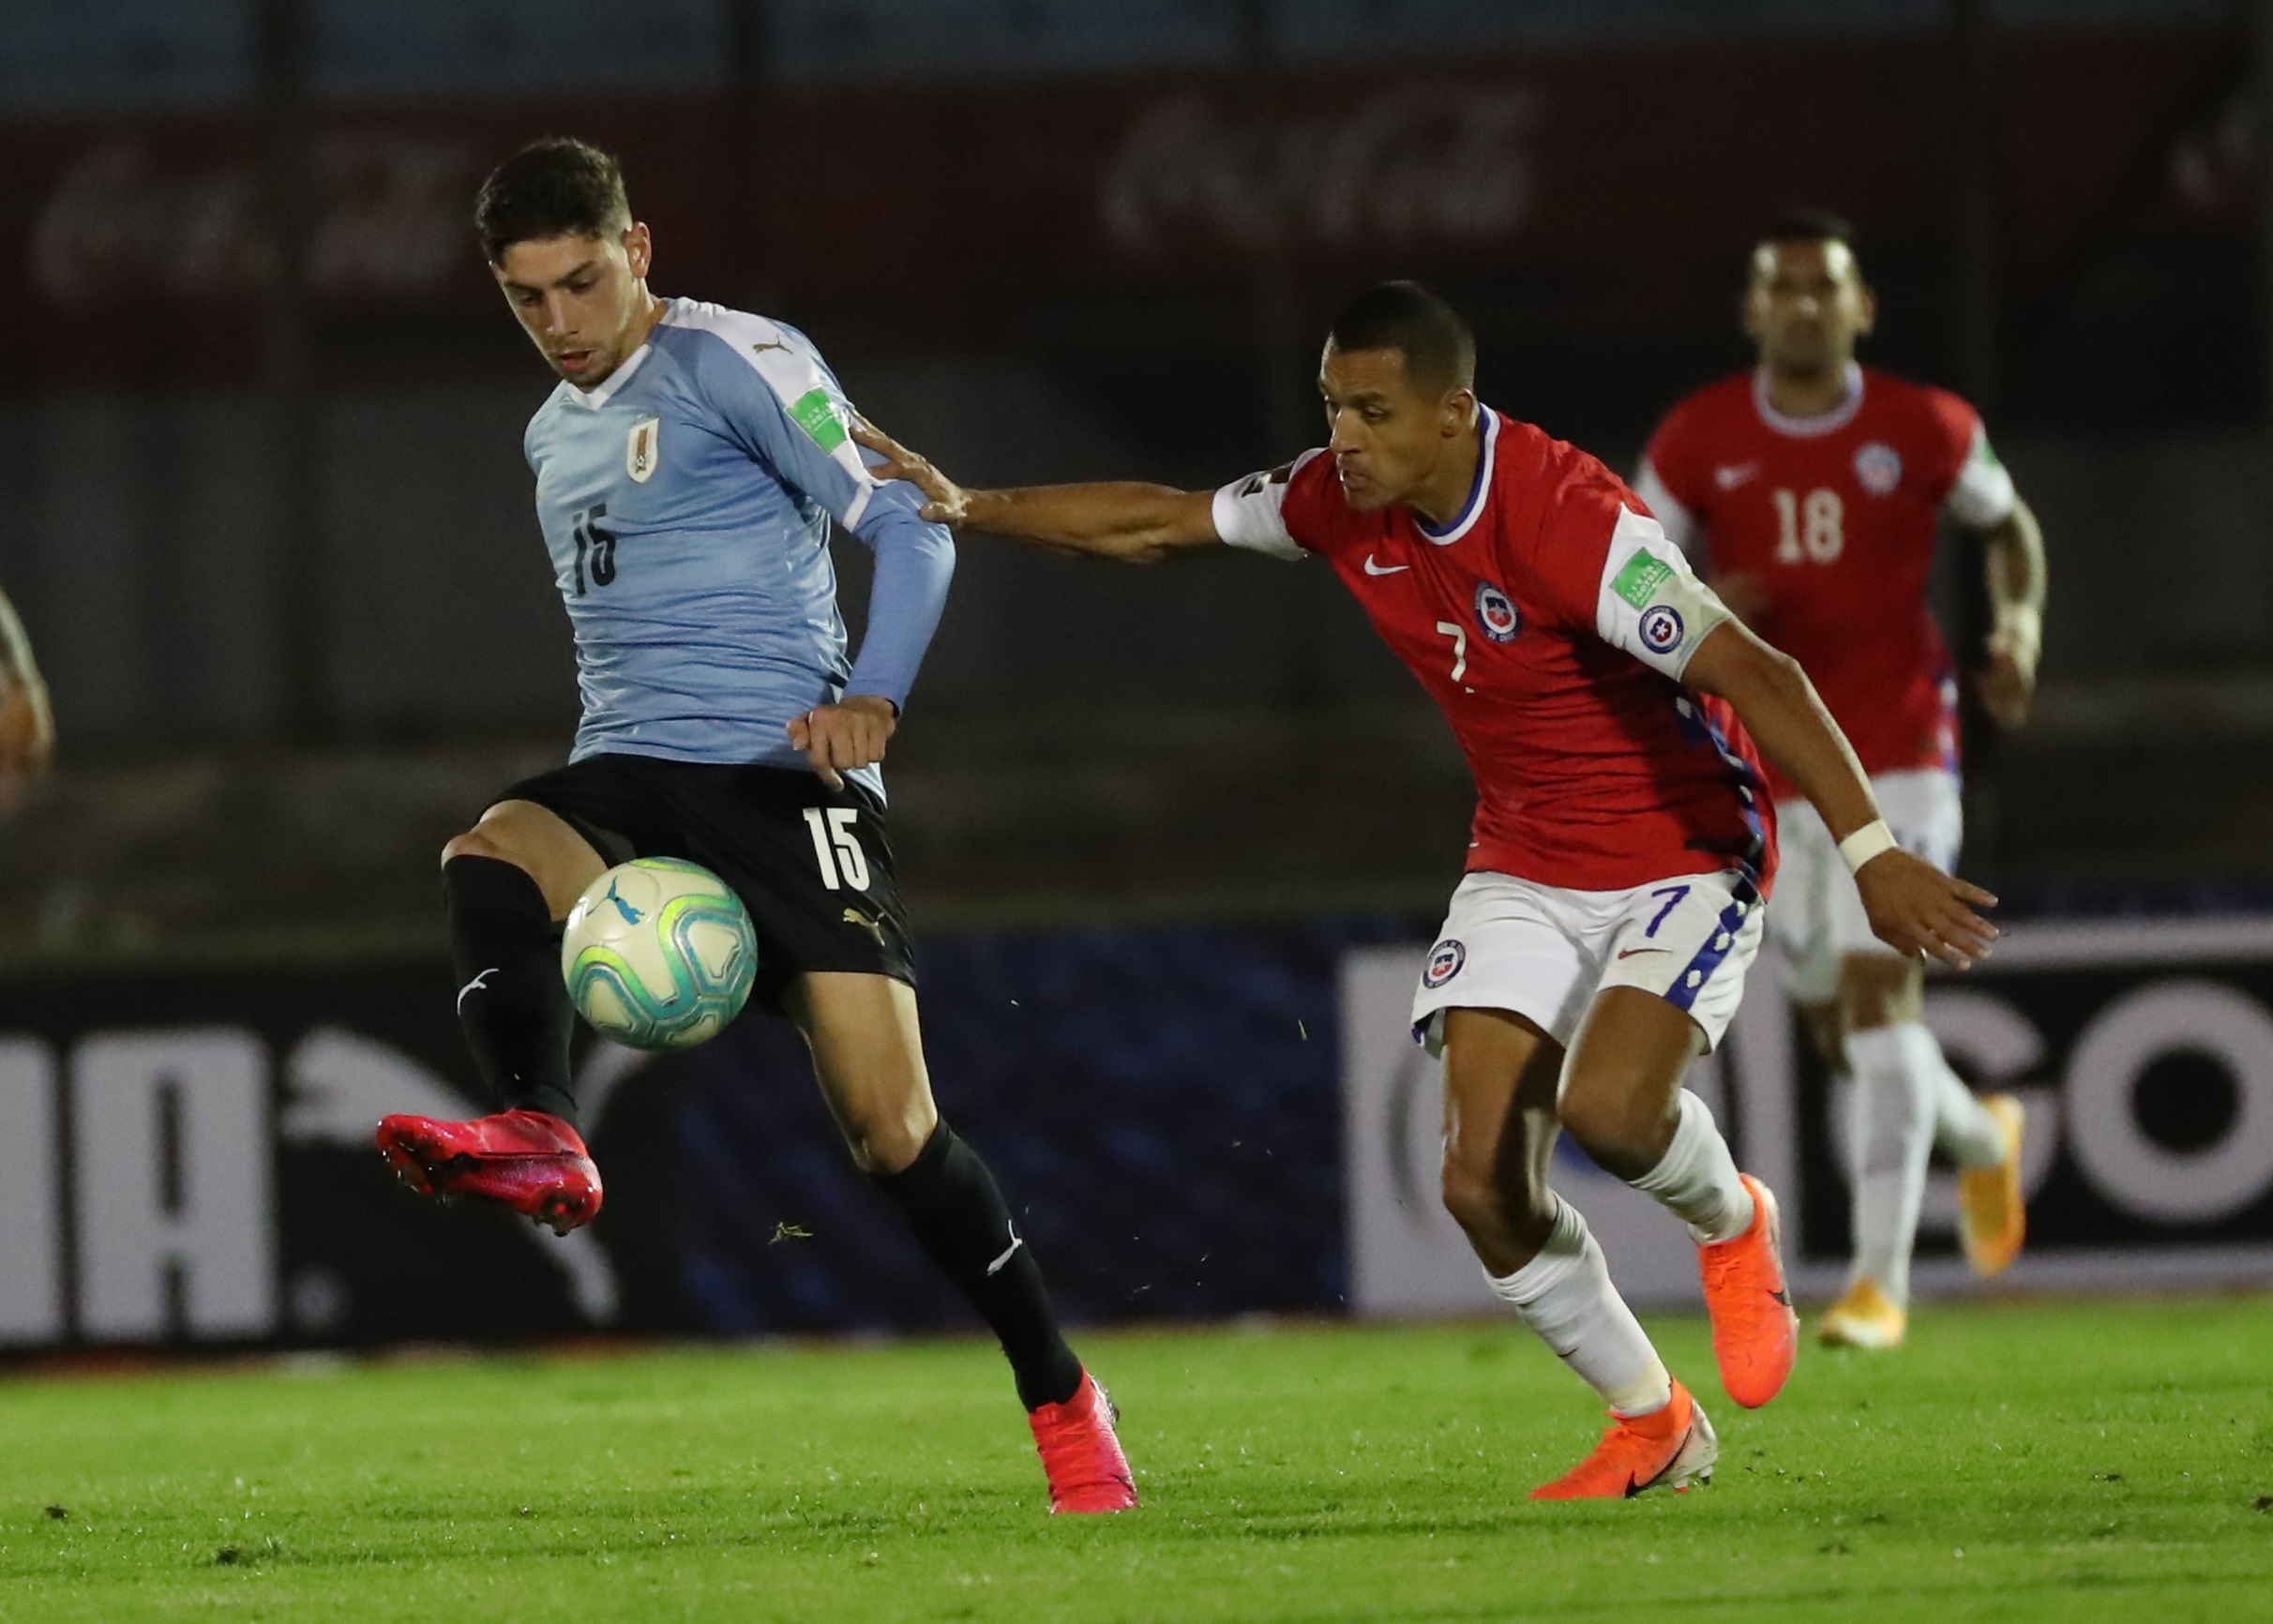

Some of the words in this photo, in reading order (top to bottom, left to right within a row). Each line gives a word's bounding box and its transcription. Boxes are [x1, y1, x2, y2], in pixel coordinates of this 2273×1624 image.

[573, 502, 617, 597] 15
[1772, 487, 1844, 564] 18
[1436, 620, 1473, 693] 7
[802, 806, 871, 892] 15
[1645, 884, 1691, 938] 7
